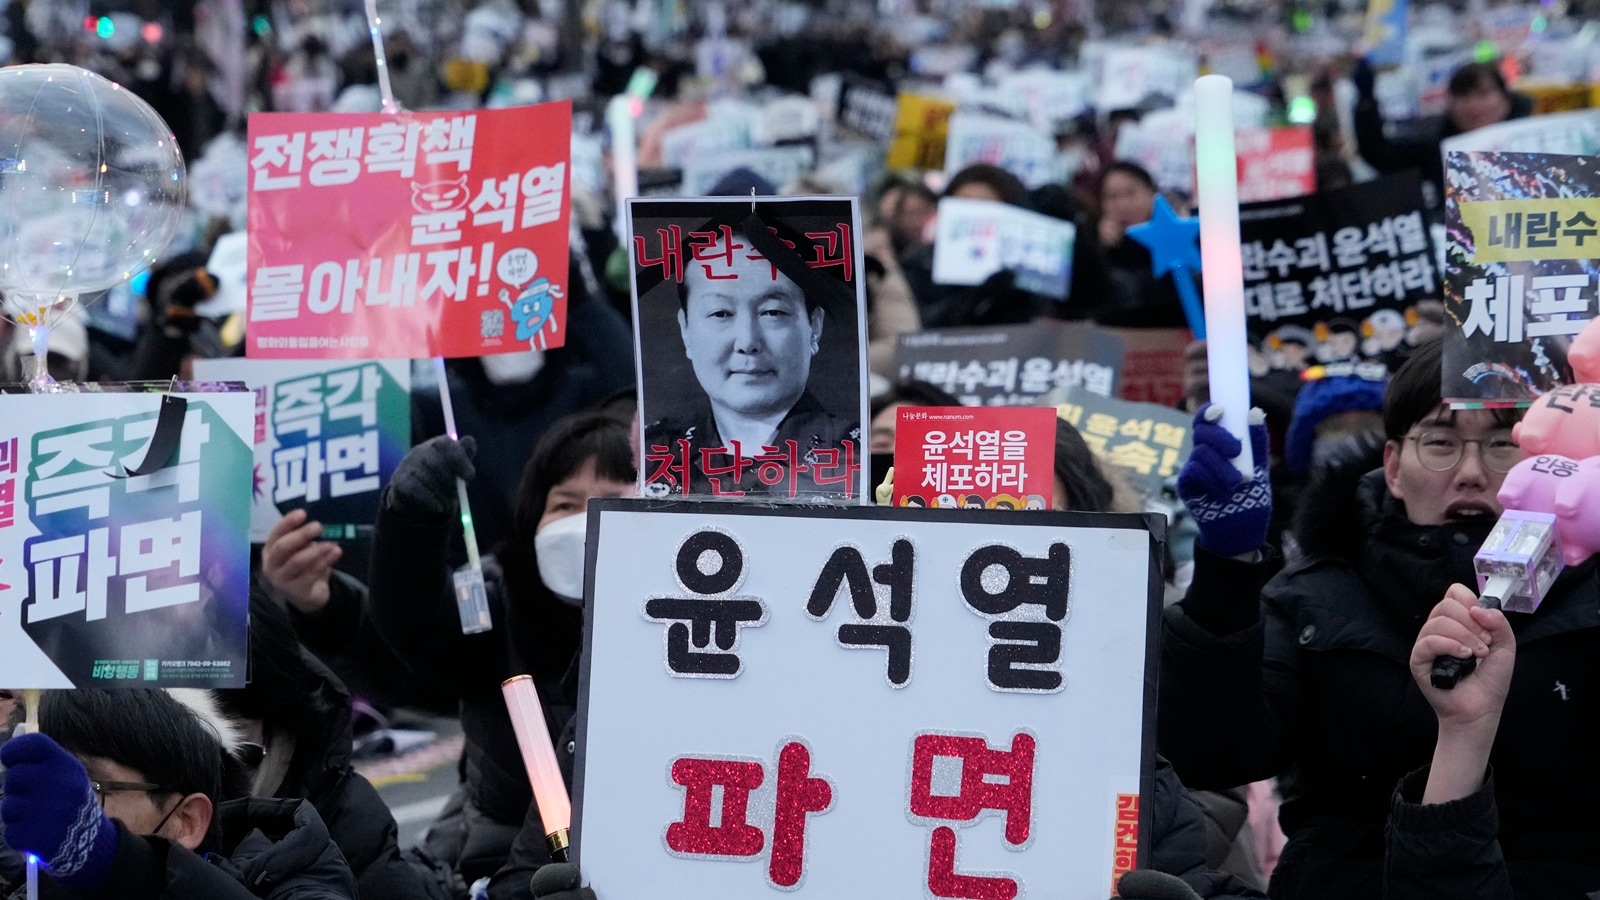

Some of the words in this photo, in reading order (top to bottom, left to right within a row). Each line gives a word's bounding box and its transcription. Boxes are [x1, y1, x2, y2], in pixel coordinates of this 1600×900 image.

[251, 115, 476, 191] 전쟁획책
[411, 162, 565, 246] 윤석열
[1332, 210, 1427, 268] 윤석열
[1489, 211, 1598, 249] 내란수
[251, 242, 494, 322] 몰아내자!
[1307, 253, 1435, 313] 처단하라
[274, 365, 383, 437] 즉각
[31, 407, 210, 520] 즉각
[274, 430, 380, 503] 파면
[645, 439, 860, 499] 처단하라
[921, 462, 1029, 493] 체포하라
[922, 429, 1029, 461] 윤석열을
[1531, 456, 1579, 477] 인용
[27, 510, 202, 622] 파면
[641, 526, 1072, 694] 윤석열
[92, 664, 139, 679] 비상행동
[661, 727, 1040, 900] 파면
